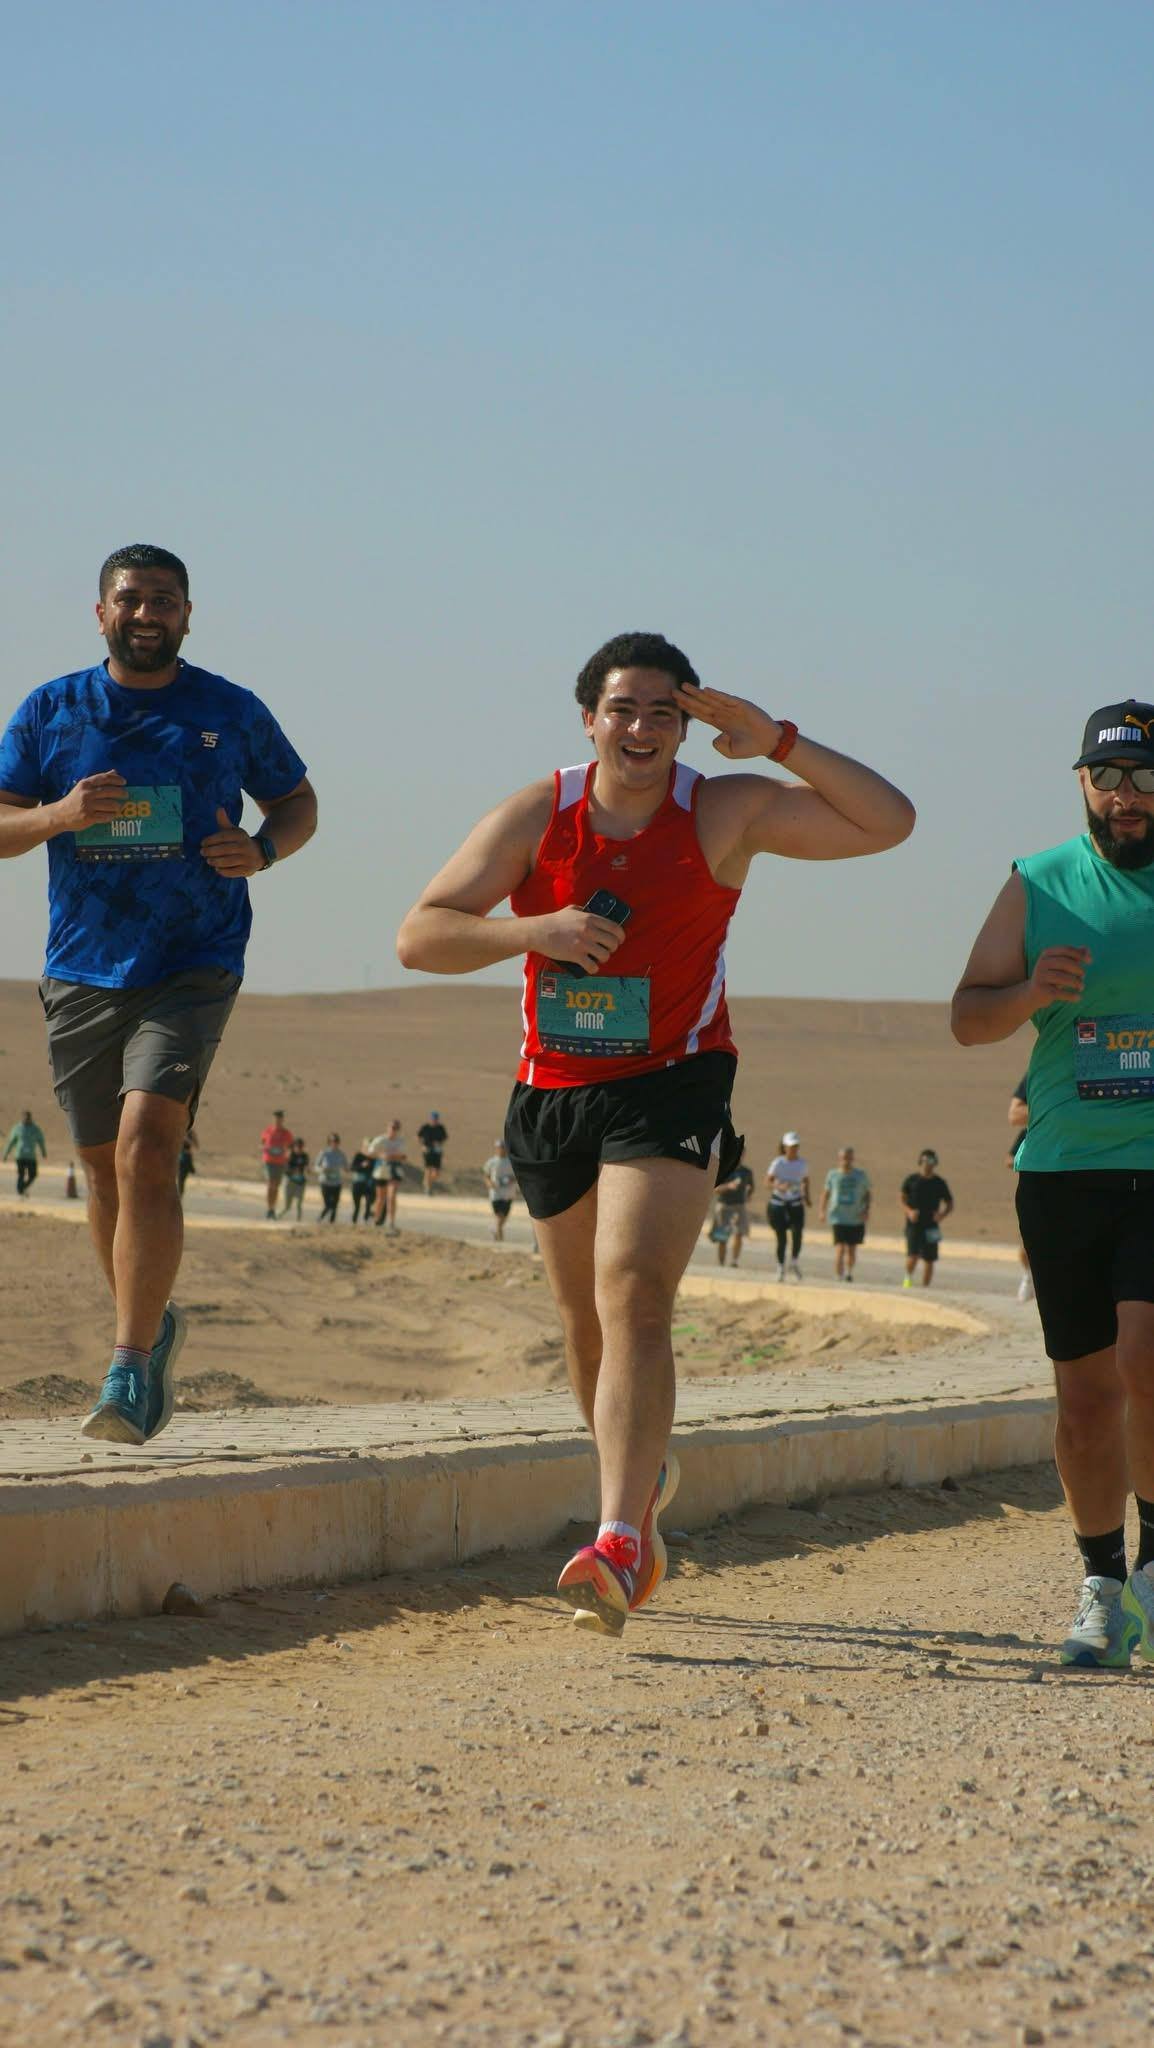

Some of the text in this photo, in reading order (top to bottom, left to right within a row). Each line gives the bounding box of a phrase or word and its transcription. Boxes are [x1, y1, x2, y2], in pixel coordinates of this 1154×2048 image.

[1098, 726, 1142, 744] PUMA
[111, 820, 142, 837] HANY
[565, 990, 616, 1011] 1071
[575, 1011, 604, 1030] AMR
[1120, 1050, 1151, 1071] AMR
